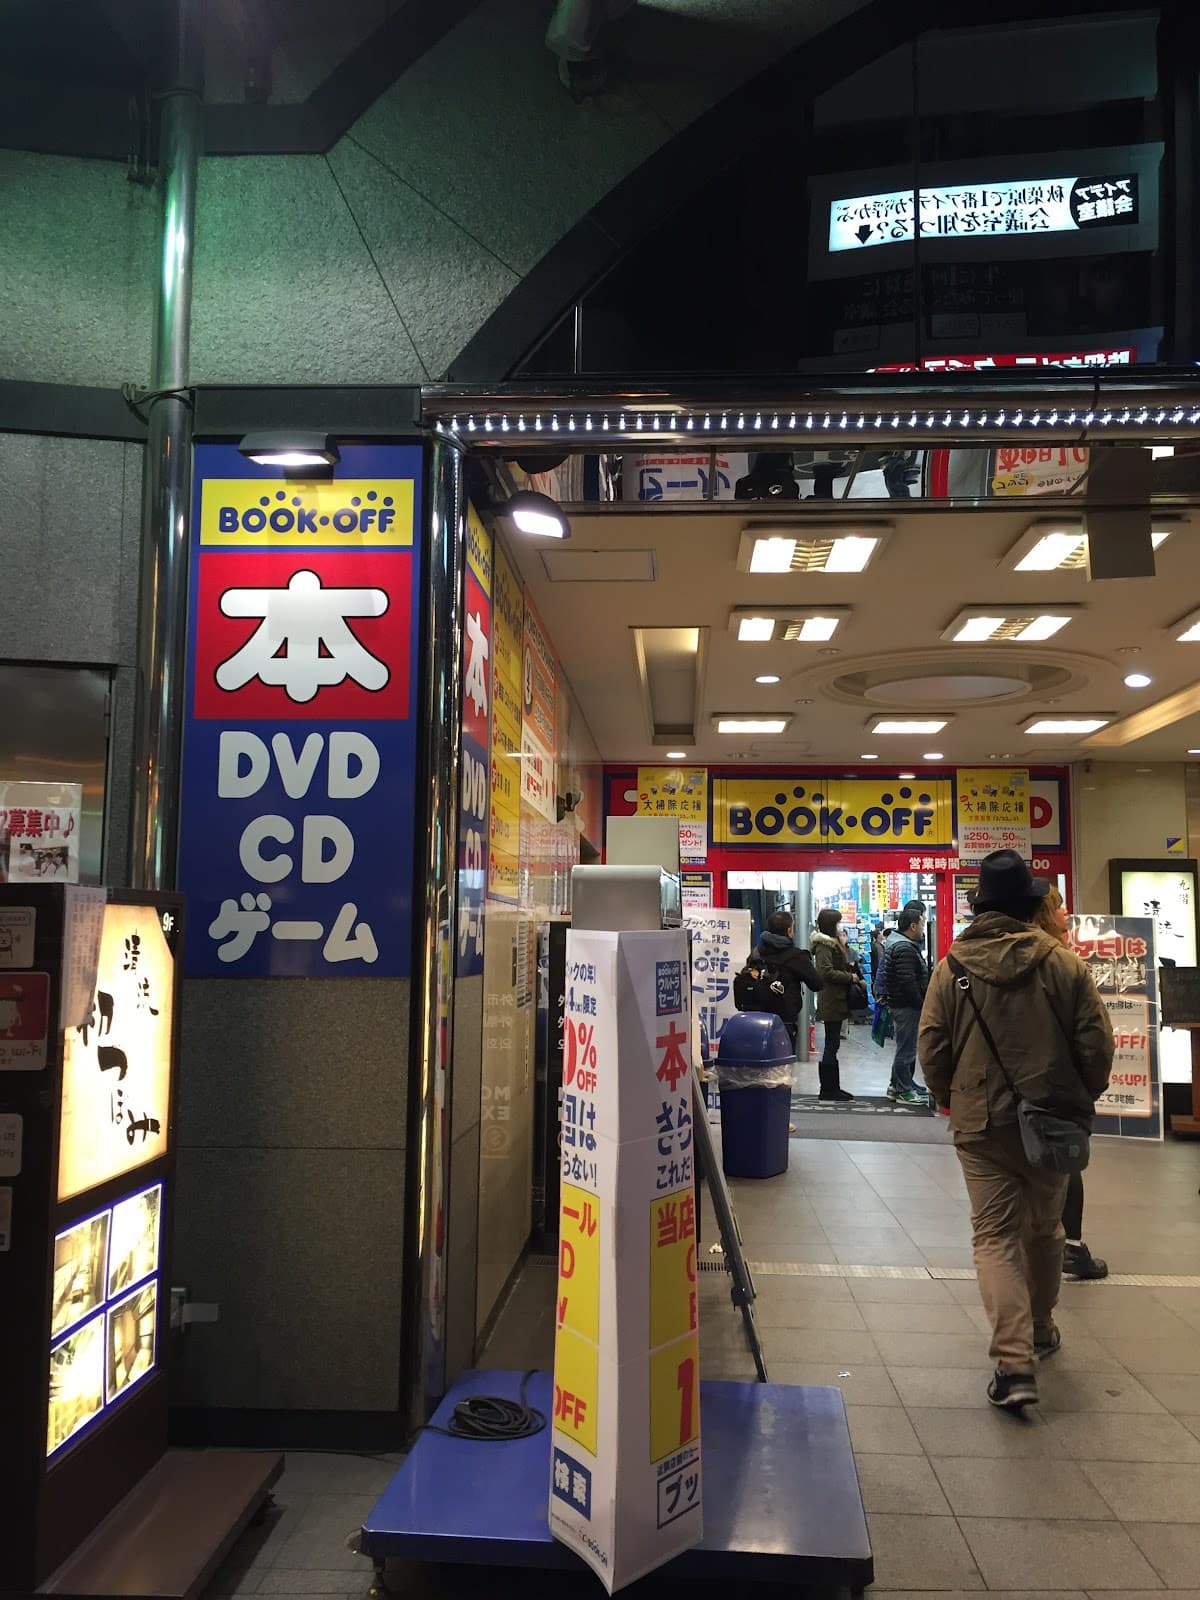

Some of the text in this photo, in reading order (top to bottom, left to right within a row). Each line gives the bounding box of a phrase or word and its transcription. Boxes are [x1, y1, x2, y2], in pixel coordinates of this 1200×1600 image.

[215, 568, 390, 703] 本
[217, 730, 381, 800] DVD
[462, 750, 486, 820] DVD
[239, 814, 355, 884] CD
[465, 828, 482, 889] CD
[908, 857, 960, 870] 営業時間
[208, 892, 379, 964] ゲーム
[577, 1068, 598, 1095] OFF
[656, 1021, 688, 1092] 本
